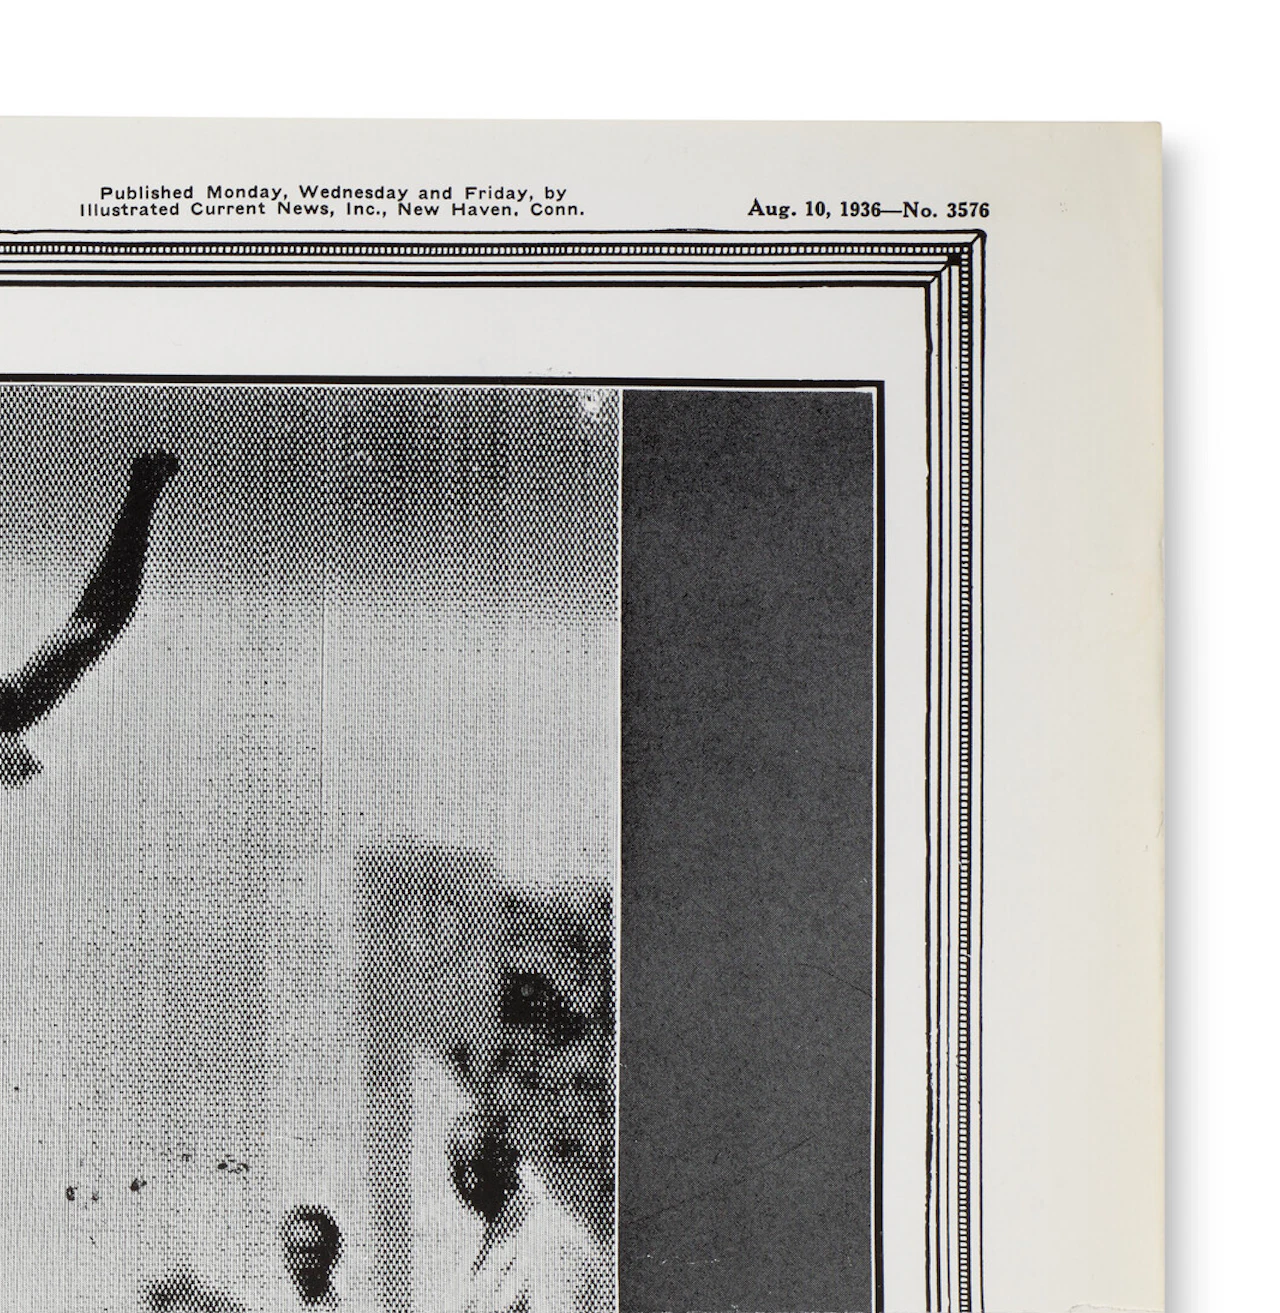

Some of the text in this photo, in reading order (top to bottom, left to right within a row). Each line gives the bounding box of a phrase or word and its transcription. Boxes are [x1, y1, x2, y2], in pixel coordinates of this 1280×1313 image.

[100, 184, 567, 203] Published Monday, Wednesday and Friday, by
[80, 202, 179, 217] Illustrated
[190, 201, 266, 216] Current
[277, 201, 335, 218] News,
[346, 201, 387, 218] Inc.,
[398, 202, 440, 216] New
[530, 202, 585, 217] Conn.
[747, 197, 797, 220] Aug.
[805, 200, 831, 220] 10,
[946, 201, 990, 219] 3576
